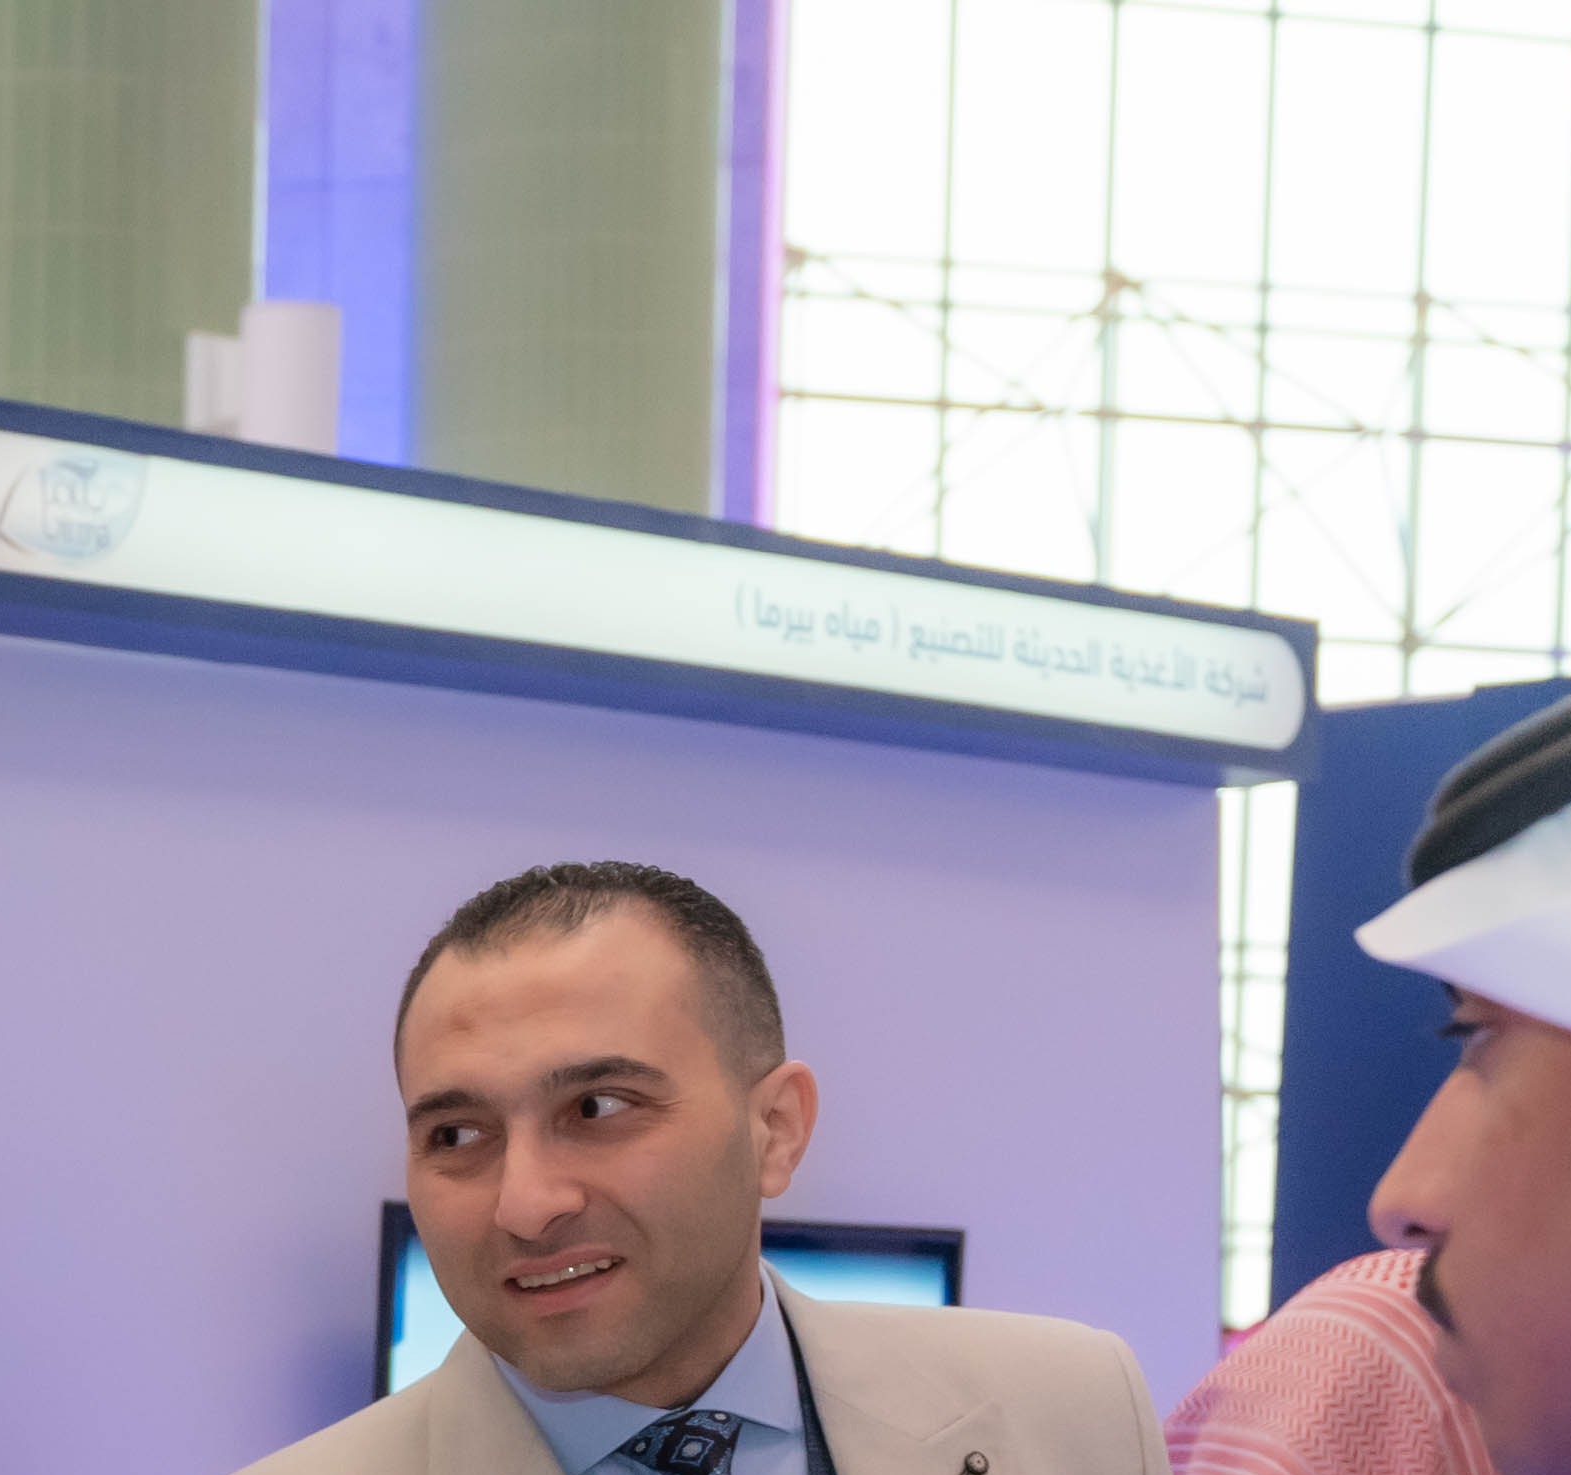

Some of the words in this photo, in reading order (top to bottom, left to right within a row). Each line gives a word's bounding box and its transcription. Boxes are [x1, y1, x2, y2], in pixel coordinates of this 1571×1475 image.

[825, 601, 880, 653] مياه
[1013, 624, 1103, 680] الحديثة
[1205, 657, 1267, 708] شركة
